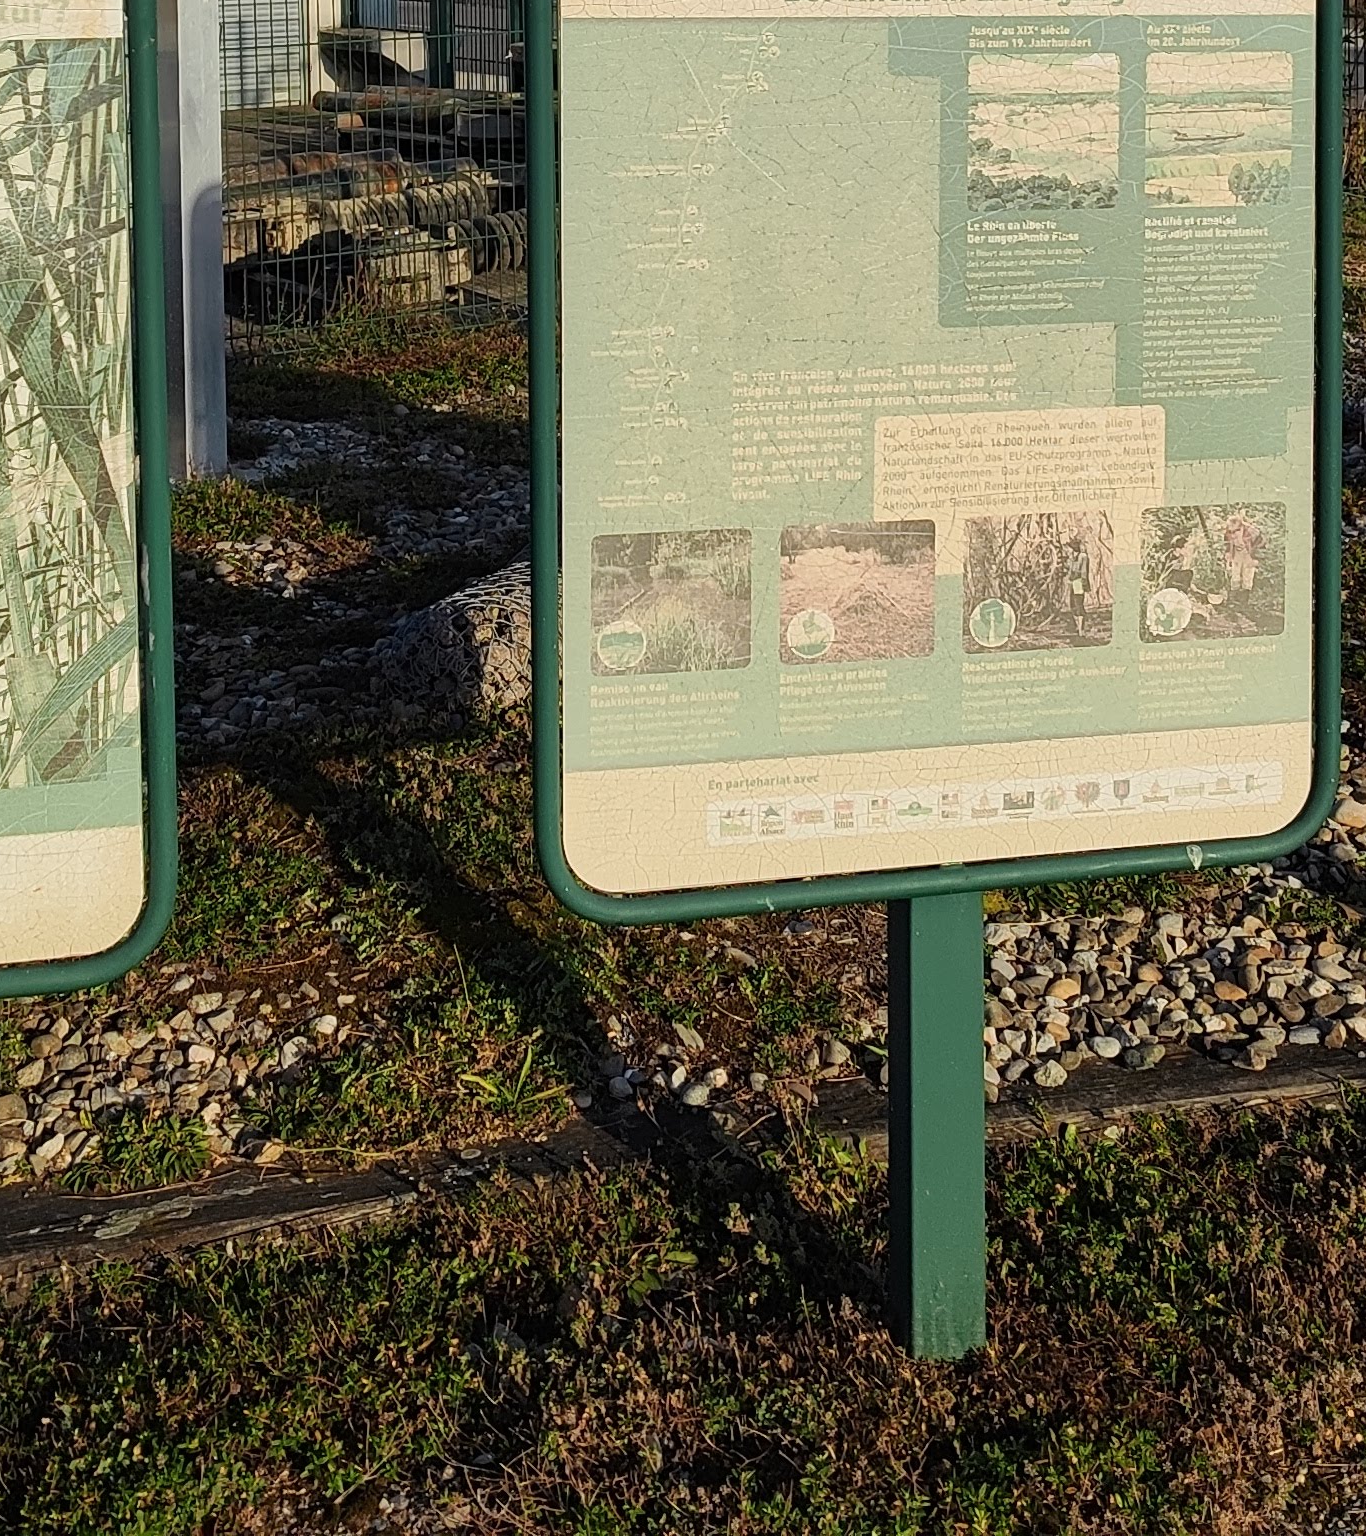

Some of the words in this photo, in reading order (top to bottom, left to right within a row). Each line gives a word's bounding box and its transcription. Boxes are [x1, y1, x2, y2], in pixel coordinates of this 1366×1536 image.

[970, 26, 1015, 36] Jusqu'au
[1040, 24, 1070, 35] siècle
[1146, 25, 1161, 34] Au
[969, 39, 985, 47] Bis
[1012, 38, 1026, 47] 19.
[1028, 37, 1091, 47] Jahrhundert
[1162, 37, 1177, 46] 20.
[1179, 36, 1241, 46] Jahrhundert
[991, 437, 1023, 447] 16.000
[1030, 436, 1063, 445] Hektar
[1070, 434, 1099, 444] dieser
[1107, 432, 1156, 442] wertvollen
[708, 779, 723, 791] En
[725, 776, 791, 791] partenariat
[793, 776, 819, 784] avec
